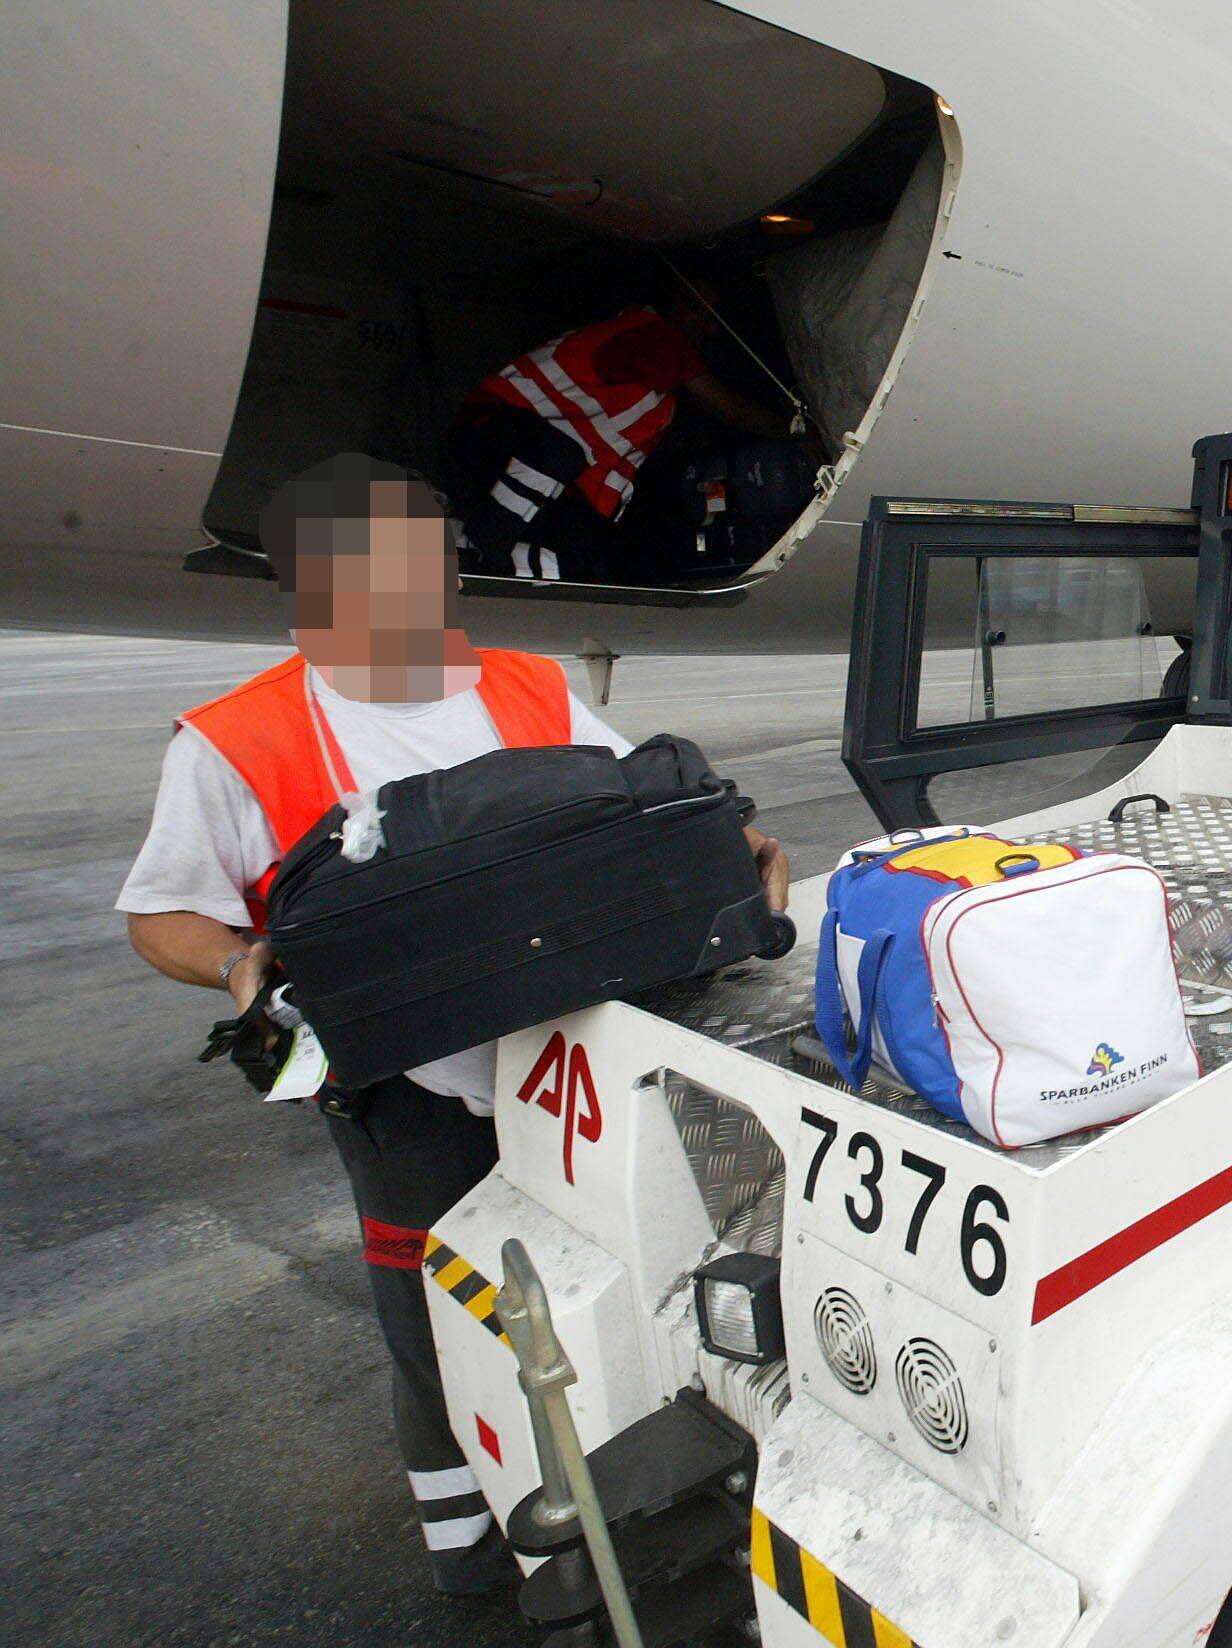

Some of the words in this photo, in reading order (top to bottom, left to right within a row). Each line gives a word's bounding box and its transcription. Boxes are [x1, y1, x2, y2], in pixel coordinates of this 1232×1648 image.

[1039, 1068, 1137, 1102] SPARBANKEN
[1140, 1053, 1168, 1075] FINN
[801, 1106, 1010, 1297] 7376
